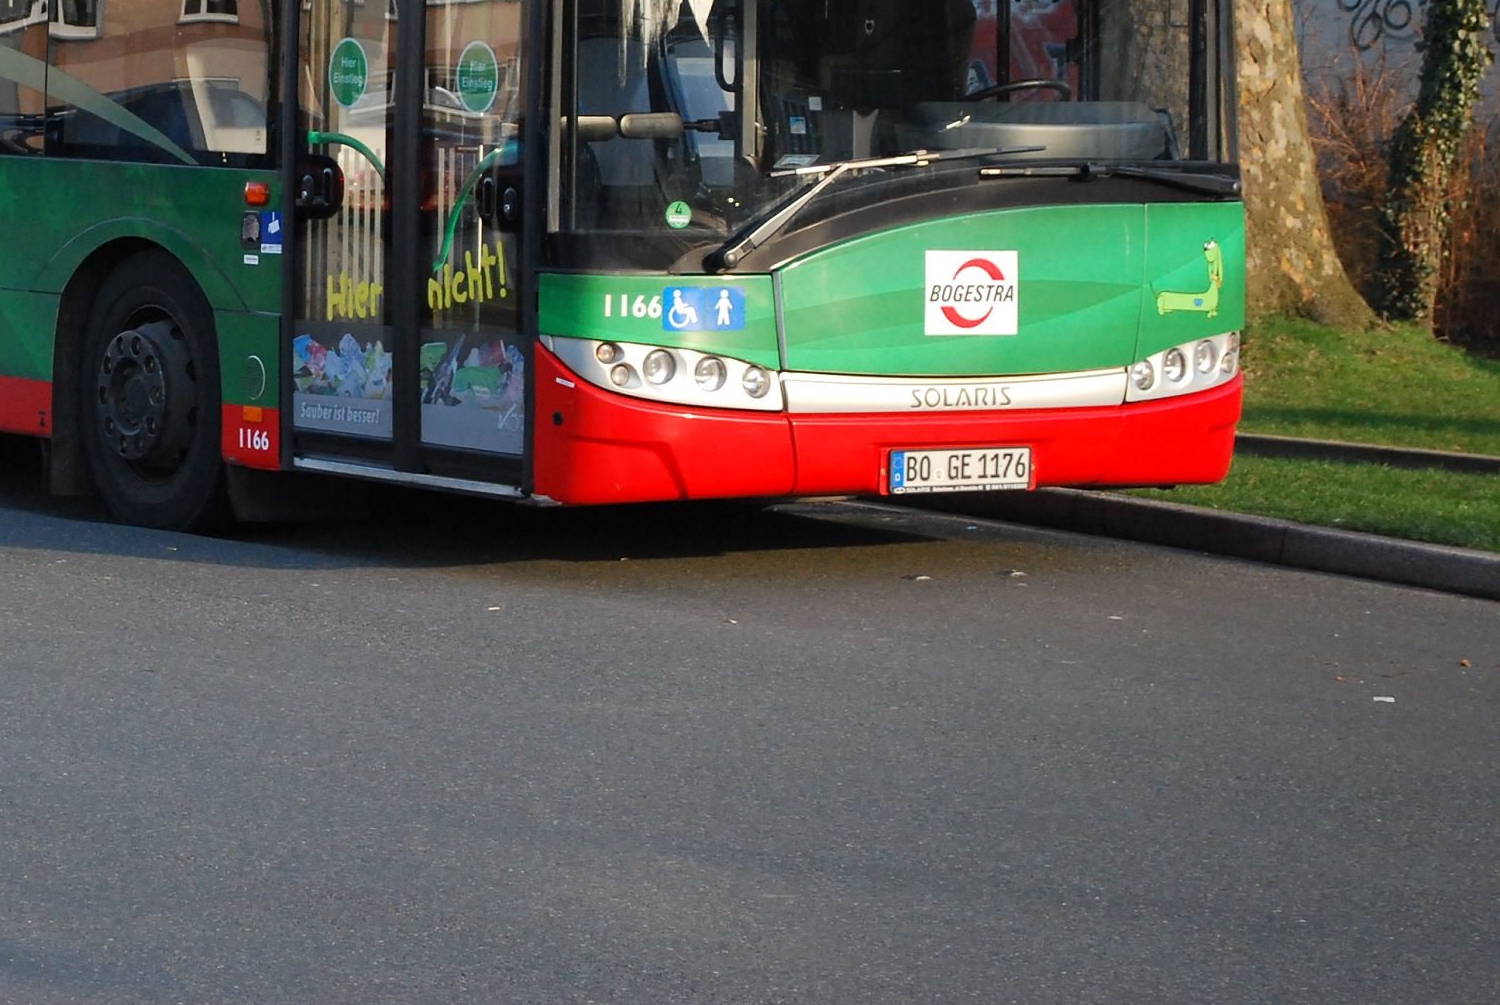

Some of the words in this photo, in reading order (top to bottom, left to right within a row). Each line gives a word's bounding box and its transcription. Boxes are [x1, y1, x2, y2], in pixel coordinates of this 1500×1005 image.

[341, 56, 357, 69] Hier
[469, 60, 486, 72] Hier
[333, 72, 364, 88] Einstieg
[461, 76, 493, 92] Einstieg
[326, 270, 384, 322] Hier
[428, 240, 507, 311] nicht!
[929, 284, 1014, 303] BOGESTRA
[604, 293, 662, 319] 1166
[910, 386, 1012, 408] SOLARIS
[301, 401, 332, 420] Sauber
[239, 427, 269, 451] 1166
[906, 456, 931, 482] BO
[948, 454, 972, 480] GE
[978, 452, 1026, 479] 1176
